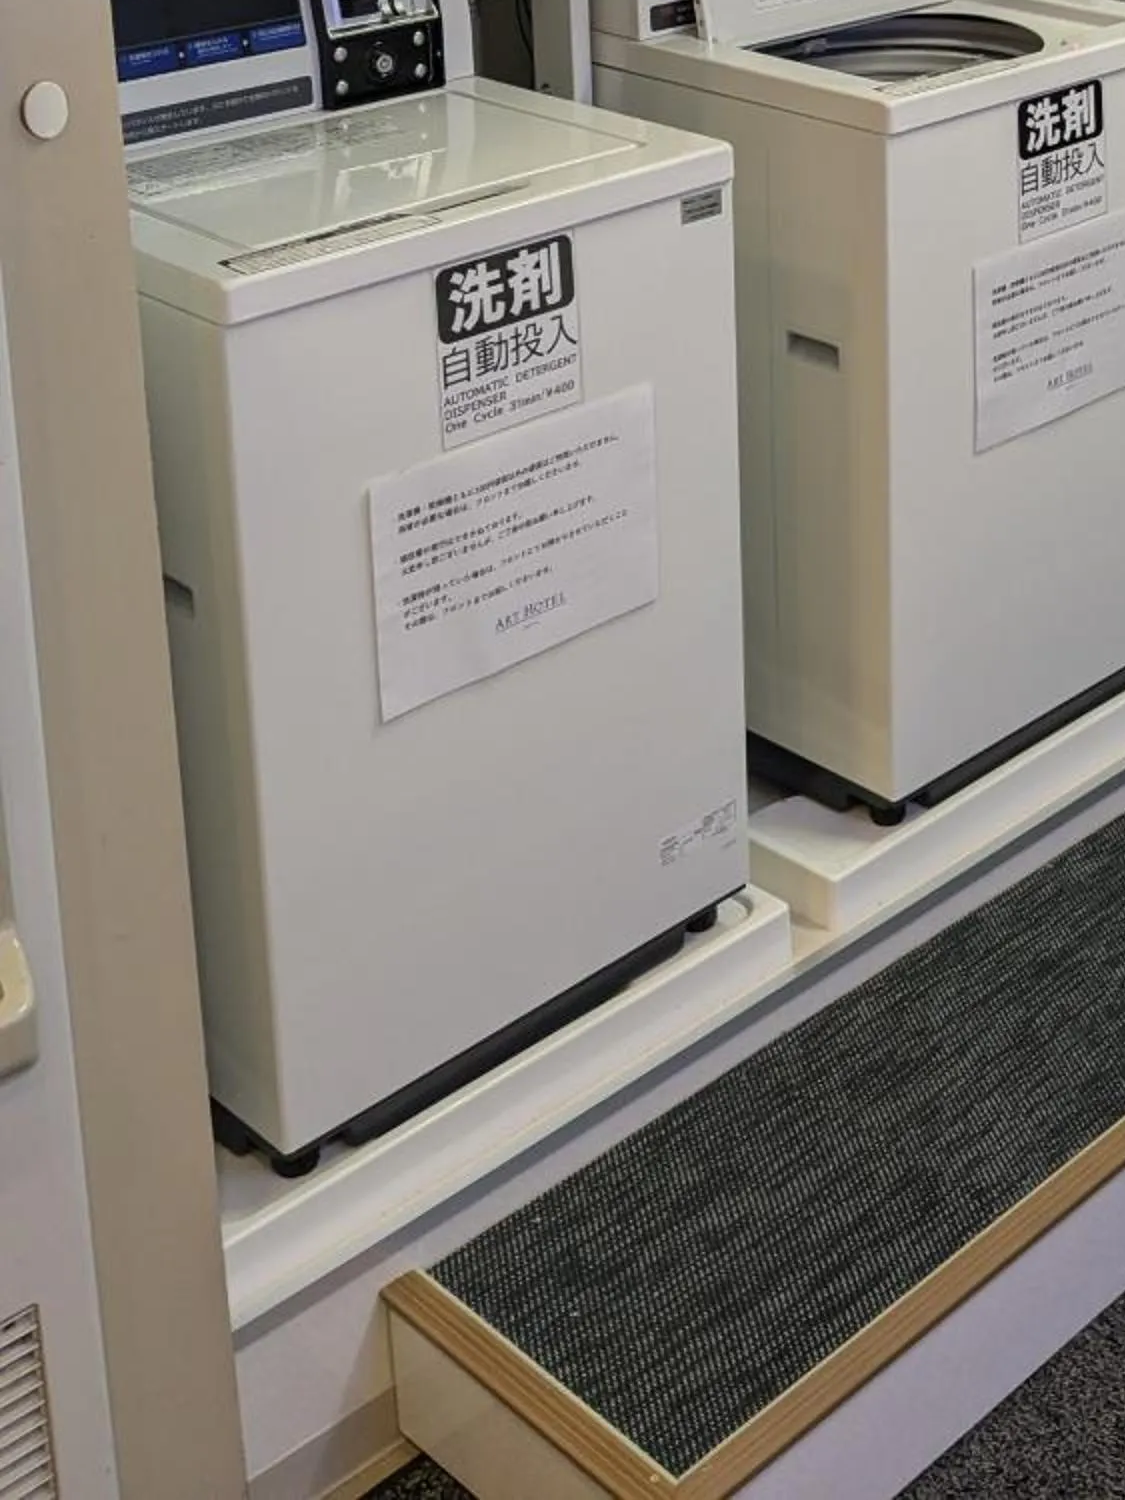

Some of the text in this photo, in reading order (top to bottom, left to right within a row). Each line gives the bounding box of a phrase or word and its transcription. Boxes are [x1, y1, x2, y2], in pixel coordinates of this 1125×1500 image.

[1025, 83, 1096, 153] 洗剤
[1021, 143, 1105, 196] 自動投入
[448, 240, 563, 334] 洗剤
[442, 313, 578, 391] 自動投入
[443, 353, 577, 408] AUTOMATIC DETERGENT
[444, 391, 507, 421] DISPENSER
